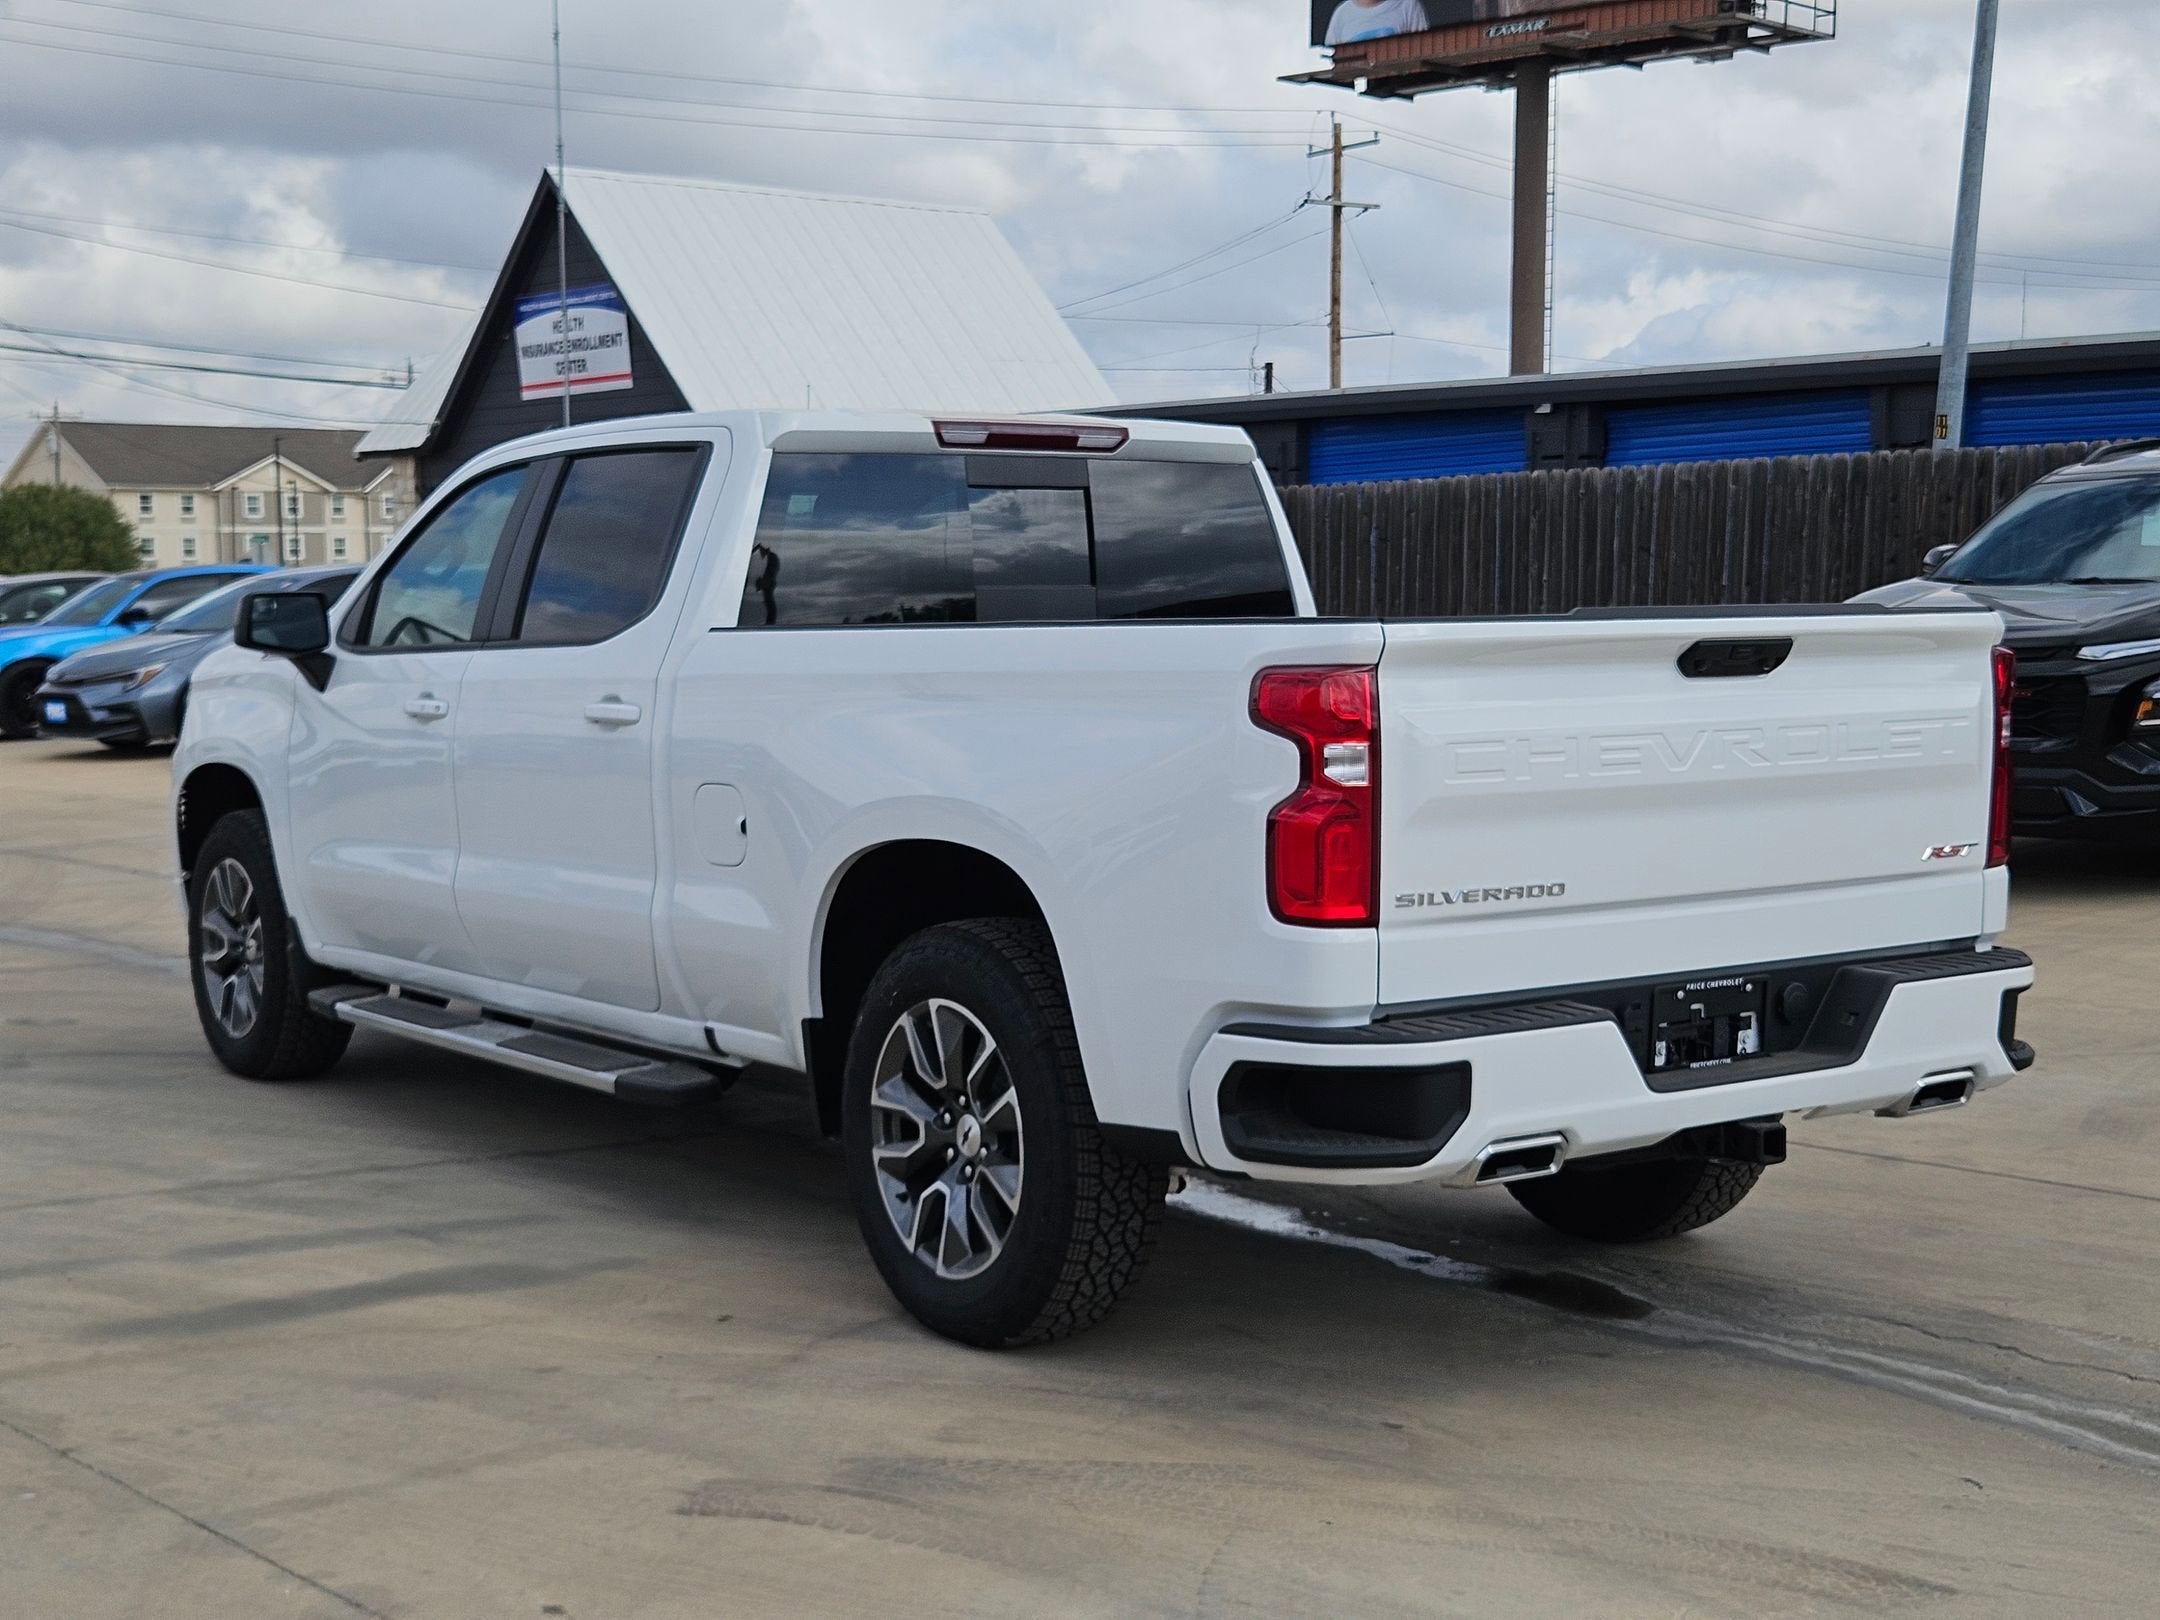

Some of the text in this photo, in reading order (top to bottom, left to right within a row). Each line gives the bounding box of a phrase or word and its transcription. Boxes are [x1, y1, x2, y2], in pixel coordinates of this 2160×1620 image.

[1488, 18, 1550, 37] LAMAR
[552, 316, 584, 334] HELTH
[566, 332, 622, 354] ENROLLMENT
[555, 358, 588, 376] CENTER
[1444, 716, 1971, 784] CHEVROLET
[1920, 842, 1979, 861] RST
[1394, 882, 1566, 909] SILVERADO
[1706, 977, 1744, 988] CHEVROLET
